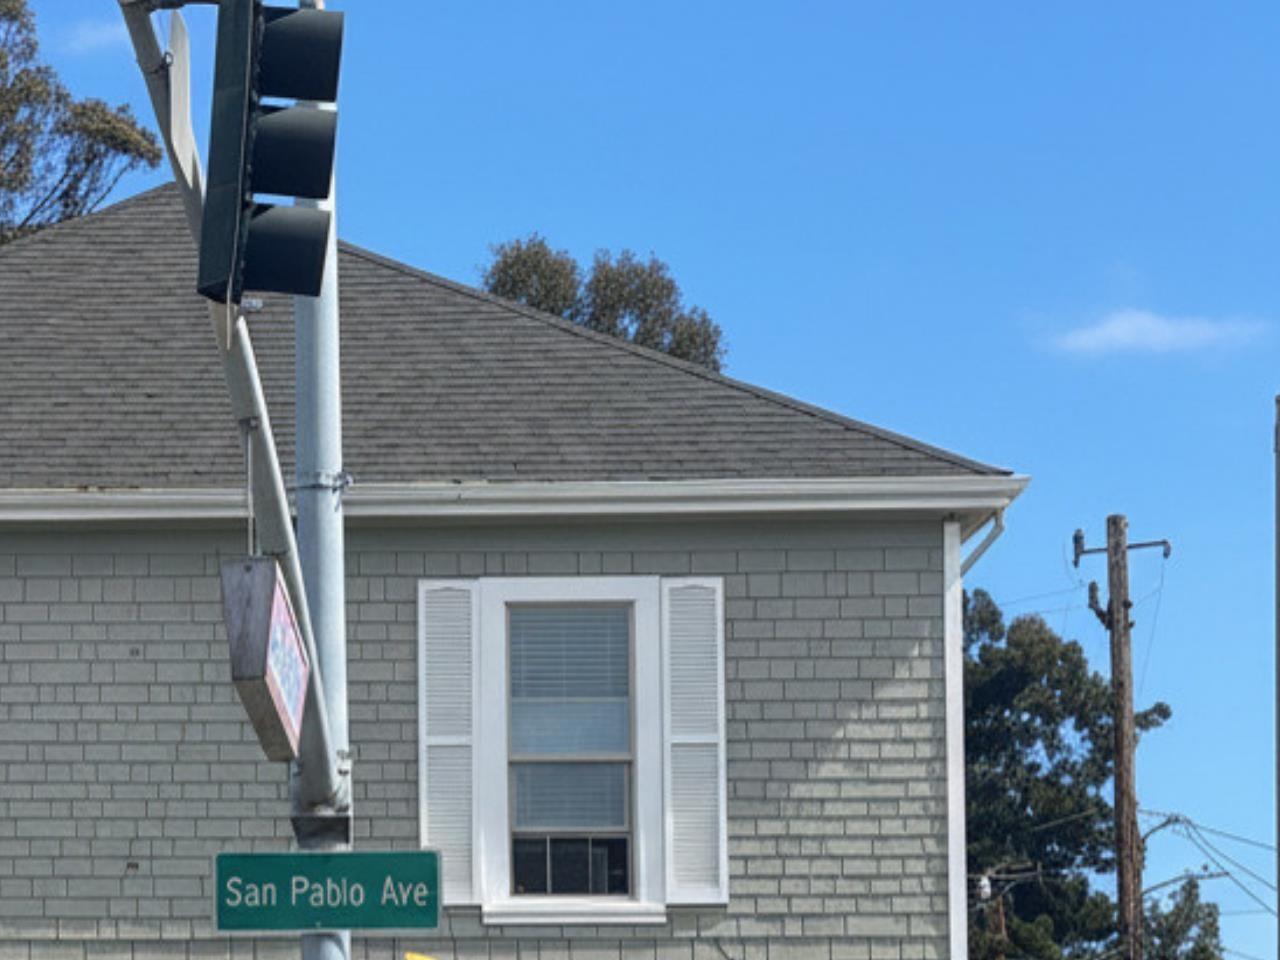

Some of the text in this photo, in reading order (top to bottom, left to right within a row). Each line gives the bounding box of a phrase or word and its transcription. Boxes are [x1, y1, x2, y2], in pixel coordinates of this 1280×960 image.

[226, 875, 429, 907] San Pablo Ave
